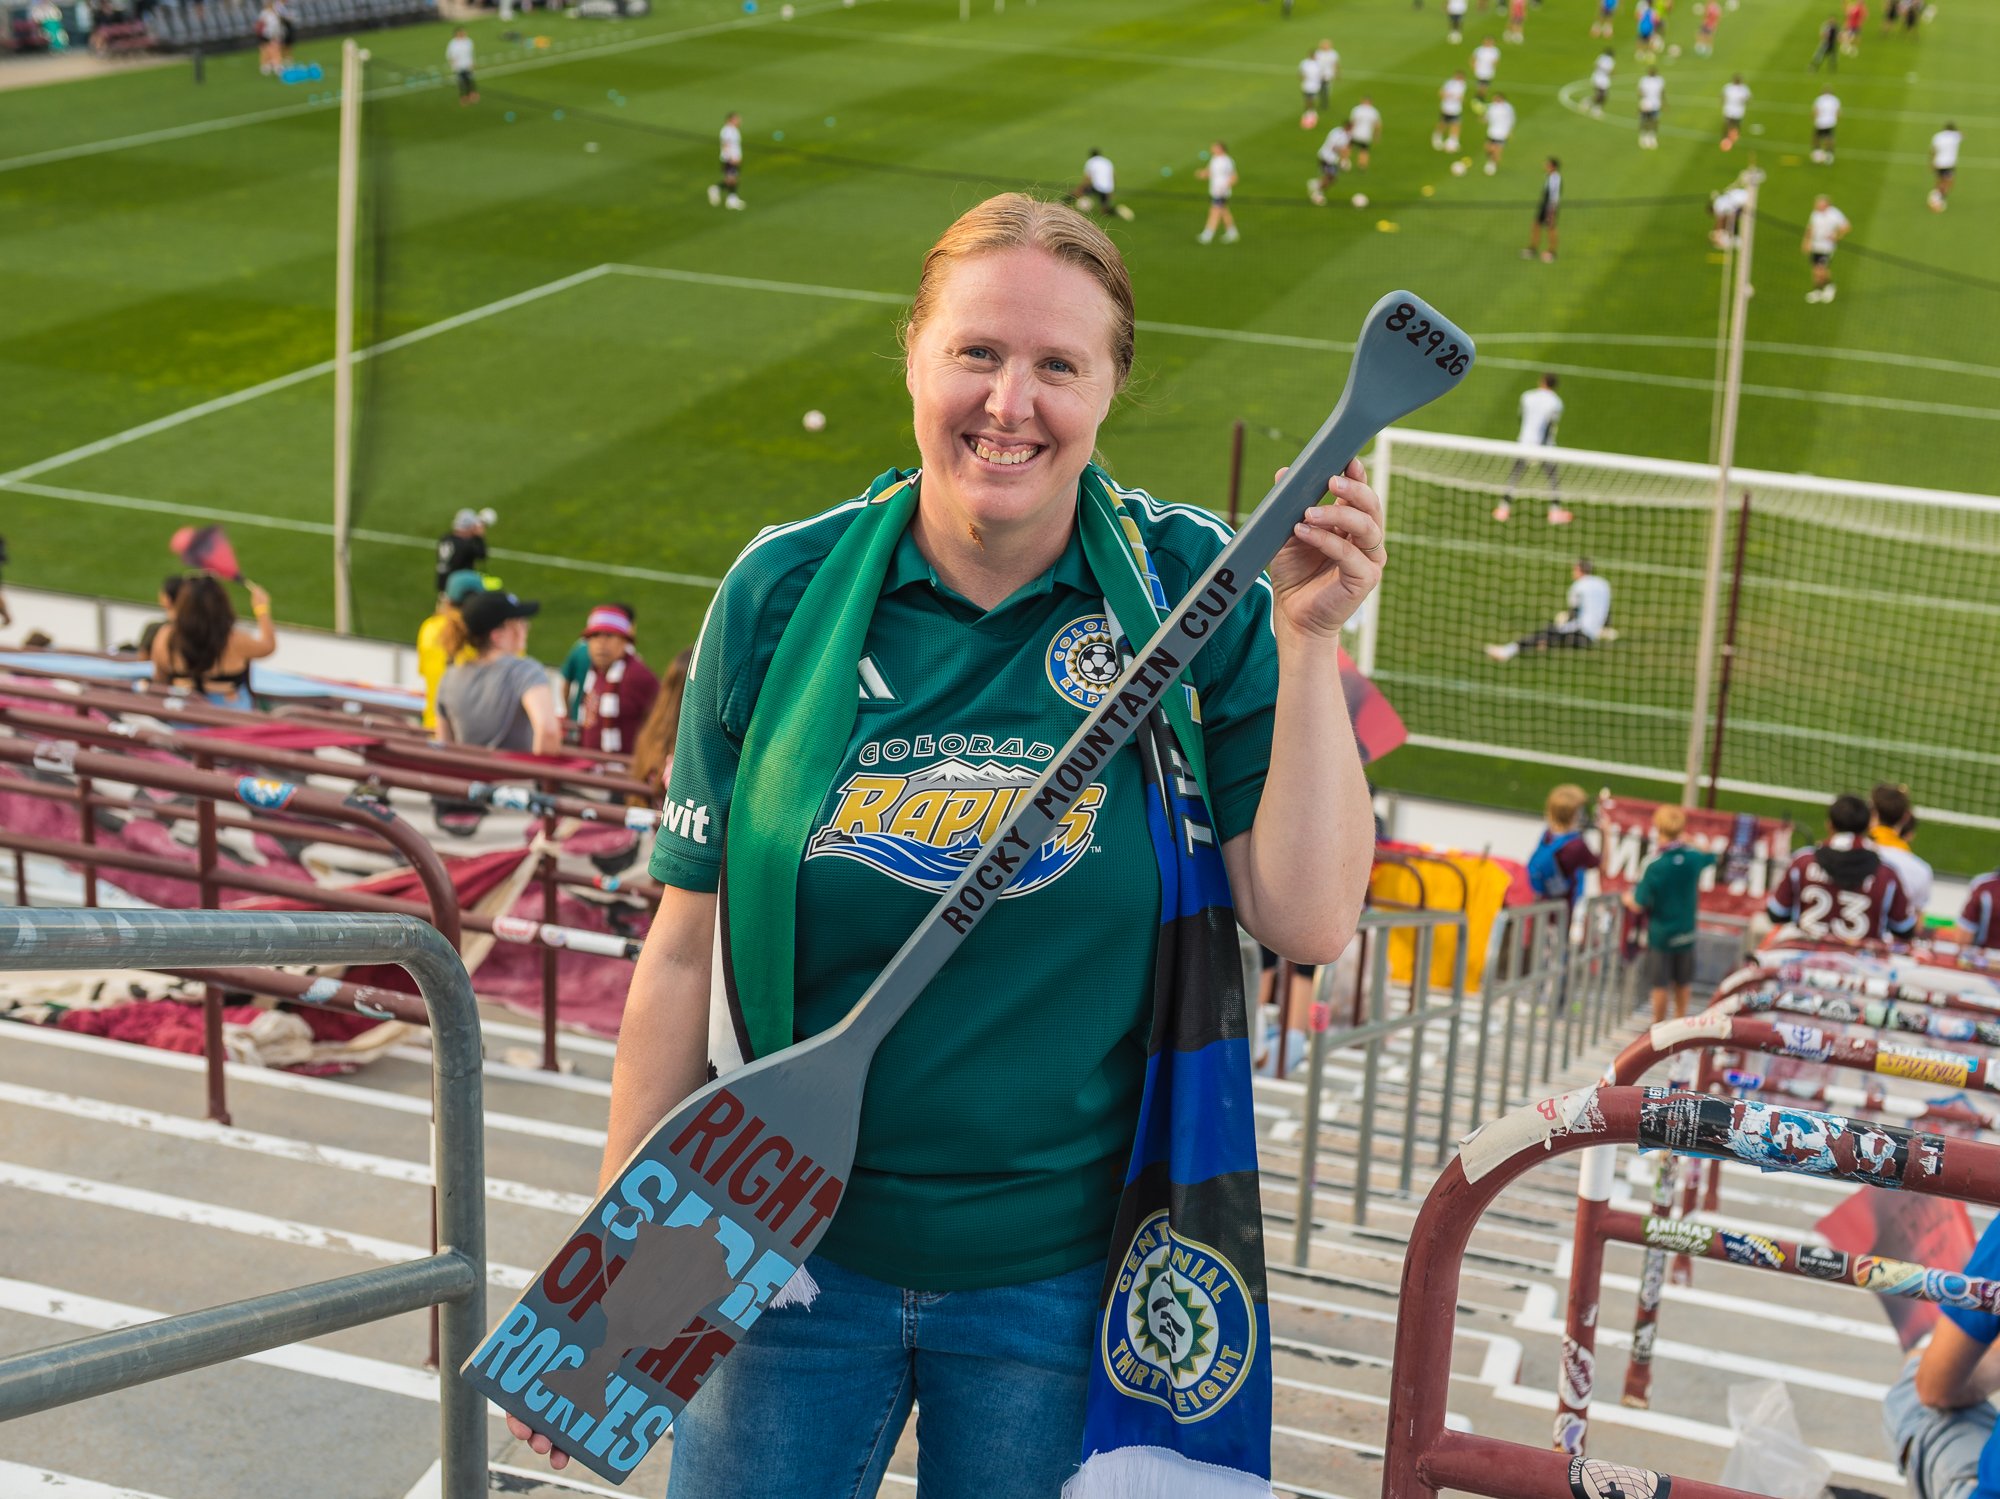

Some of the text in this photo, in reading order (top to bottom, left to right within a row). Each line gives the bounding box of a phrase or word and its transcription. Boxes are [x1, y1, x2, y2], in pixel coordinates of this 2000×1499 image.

[1054, 621, 1111, 662] COLOR
[1060, 677, 1104, 704] RAP
[858, 733, 1055, 767] COLORAD
[940, 568, 1239, 934] ROCKY MOUNTAIN CUP
[830, 772, 1107, 850] RAPIS
[1090, 845, 1102, 853] TM
[1800, 884, 1872, 941] 23
[669, 1088, 844, 1249] RIGHT
[1645, 1216, 1713, 1241] ANIMAS
[1119, 1221, 1231, 1304] CENTNIAL
[1174, 1345, 1243, 1413] EIGHT
